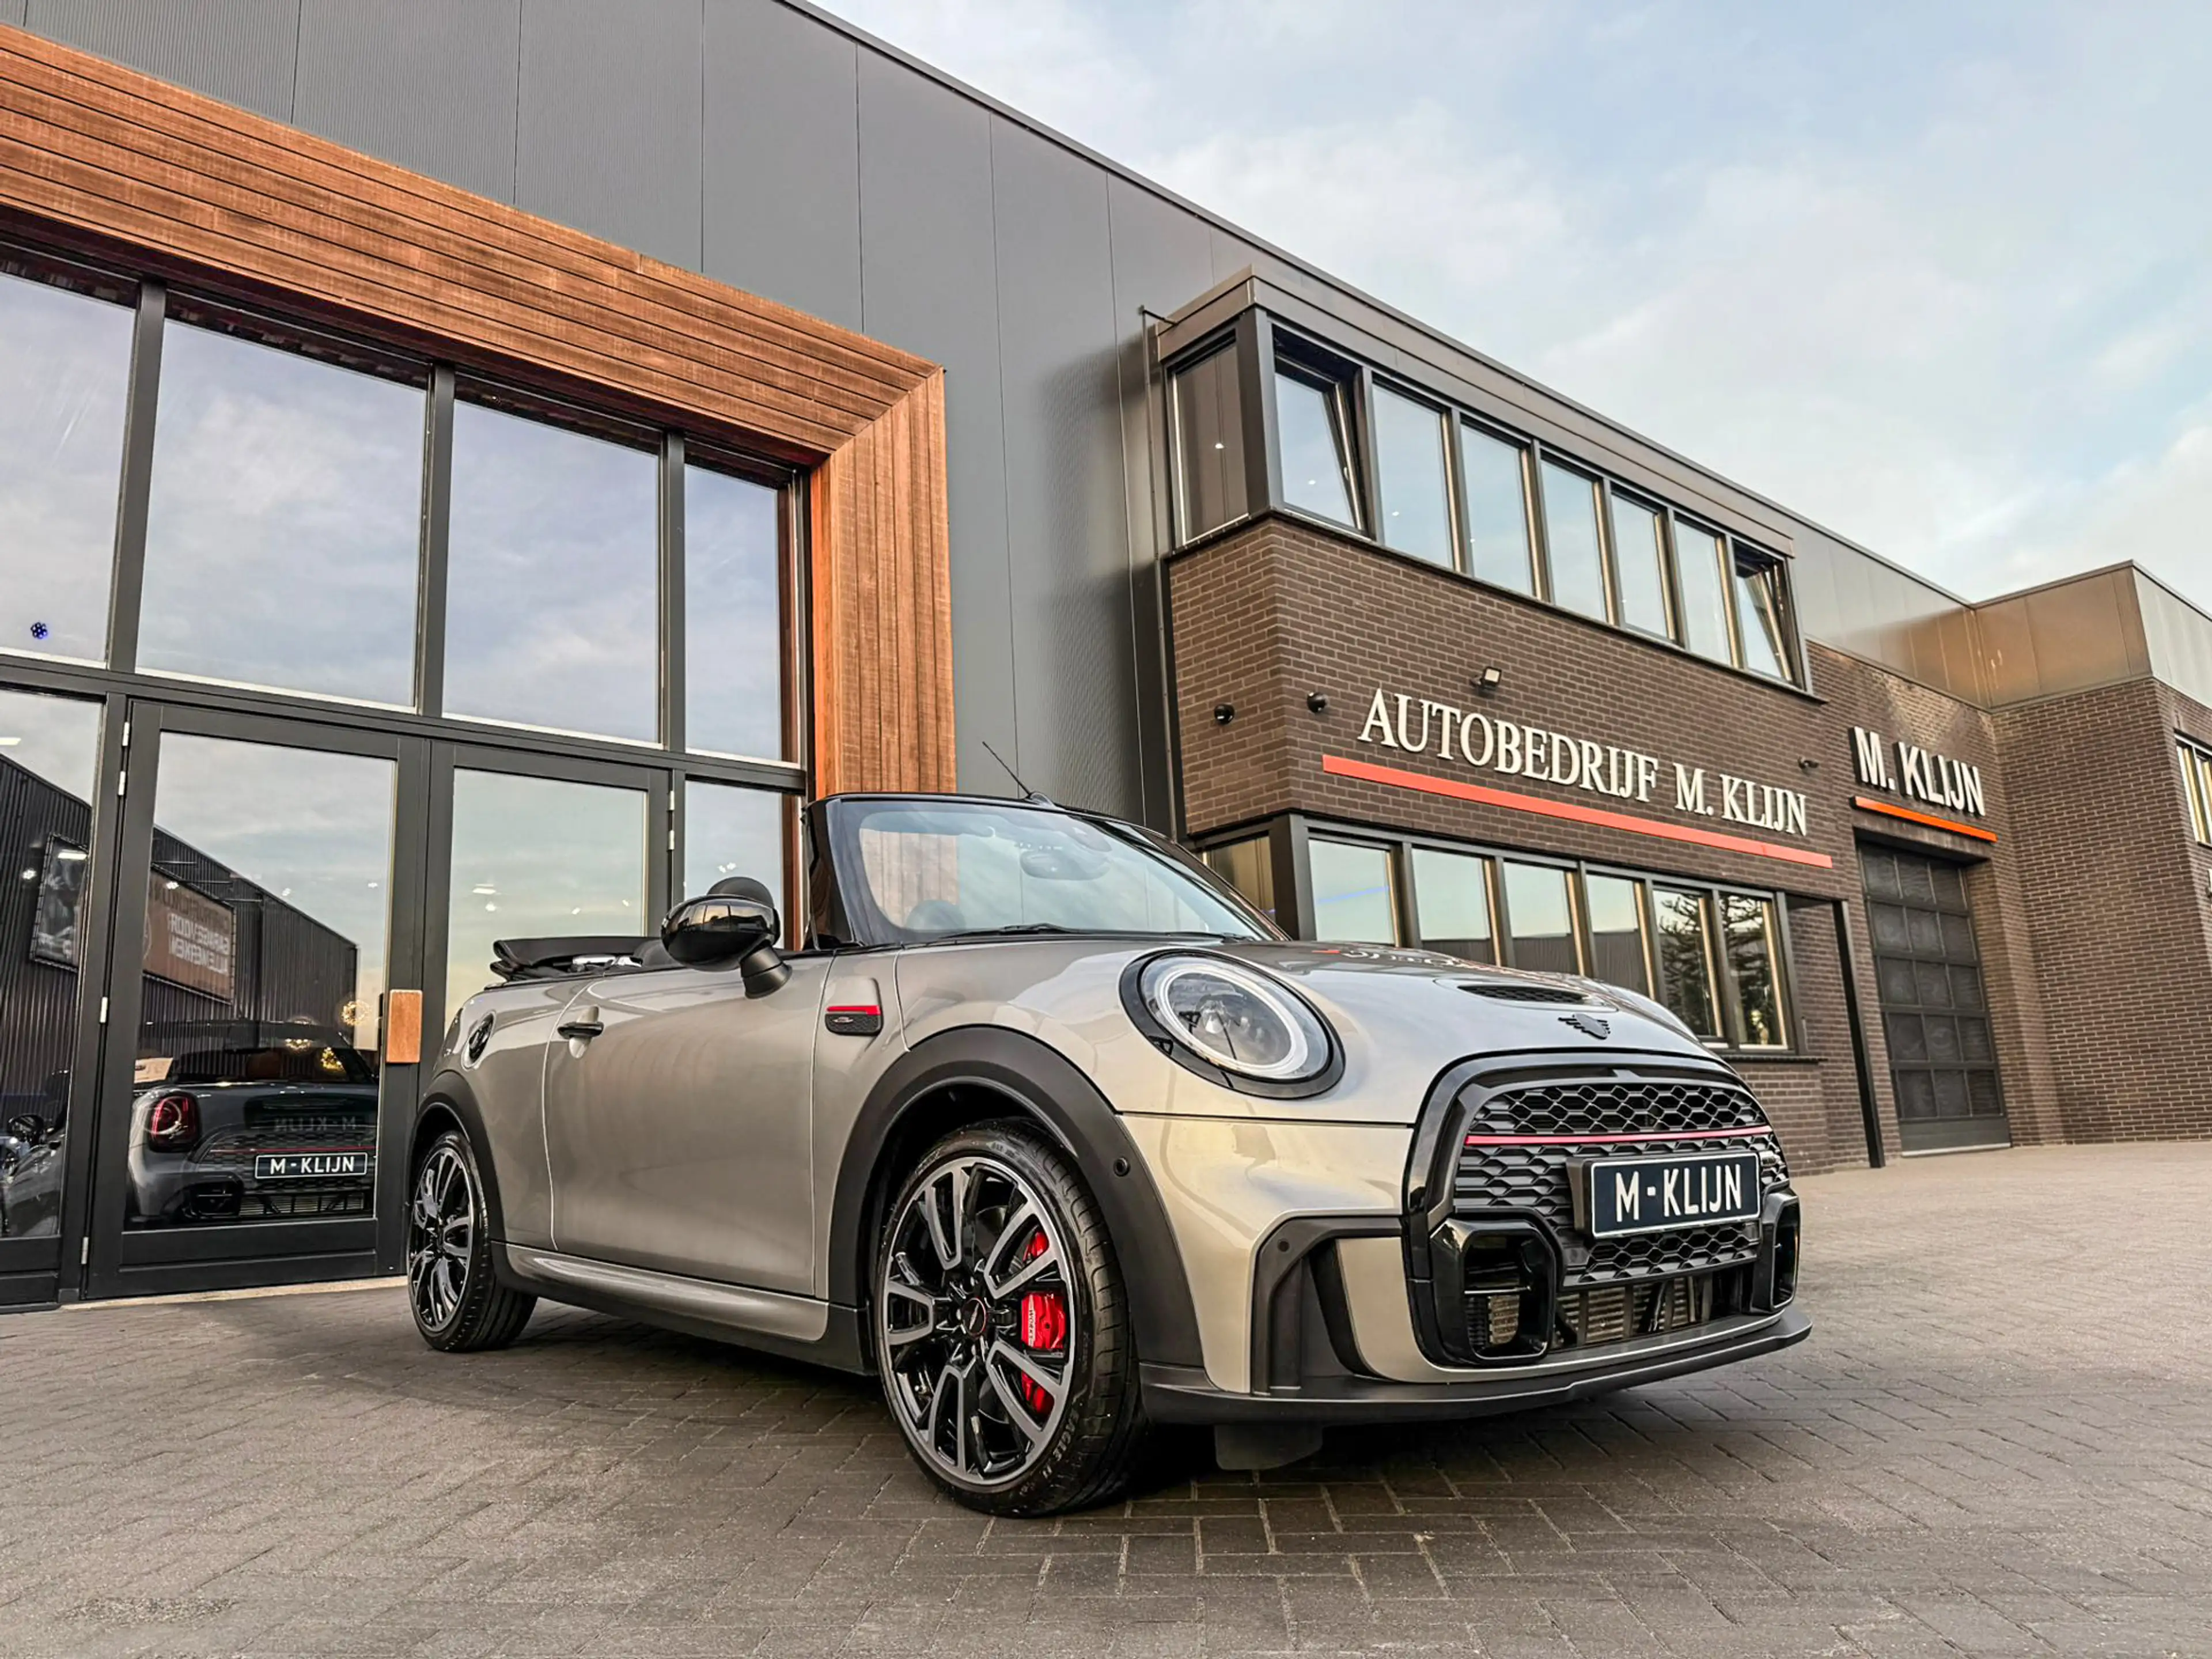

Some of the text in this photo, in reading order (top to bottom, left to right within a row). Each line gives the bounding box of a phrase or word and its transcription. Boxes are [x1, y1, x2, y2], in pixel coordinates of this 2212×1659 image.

[1357, 688, 1808, 837] AUTOBEDRIJF M. KLIJN
[1853, 726, 1986, 817] M. KLIJN
